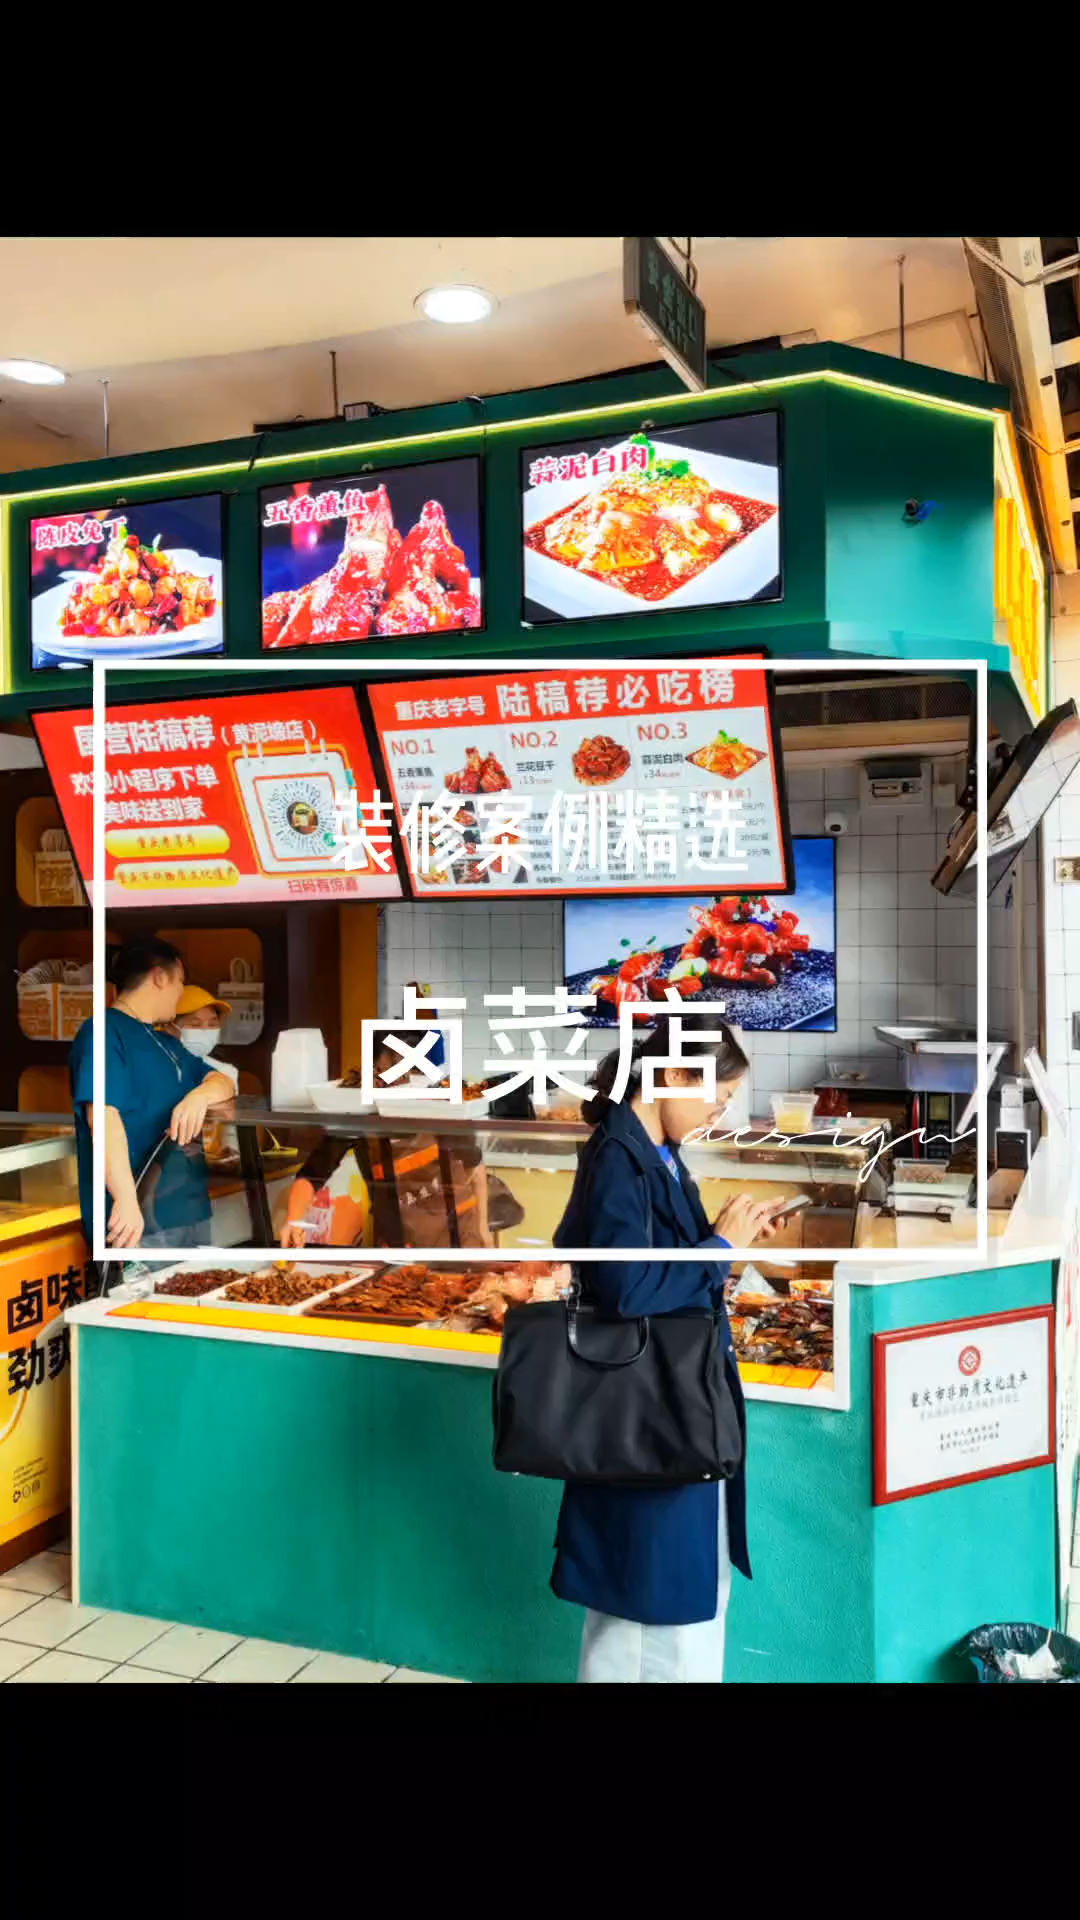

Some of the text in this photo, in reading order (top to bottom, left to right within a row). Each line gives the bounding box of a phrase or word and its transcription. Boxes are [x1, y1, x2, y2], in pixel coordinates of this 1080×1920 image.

[529, 446, 648, 486] 蒜泥白肉
[35, 515, 128, 551] 陈皮兔丁
[394, 668, 736, 721] 重庆老字号 陆稿荐必吃榜
[511, 730, 559, 749] NO.2
[636, 722, 689, 742] NO.3
[391, 737, 436, 756] NO.1
